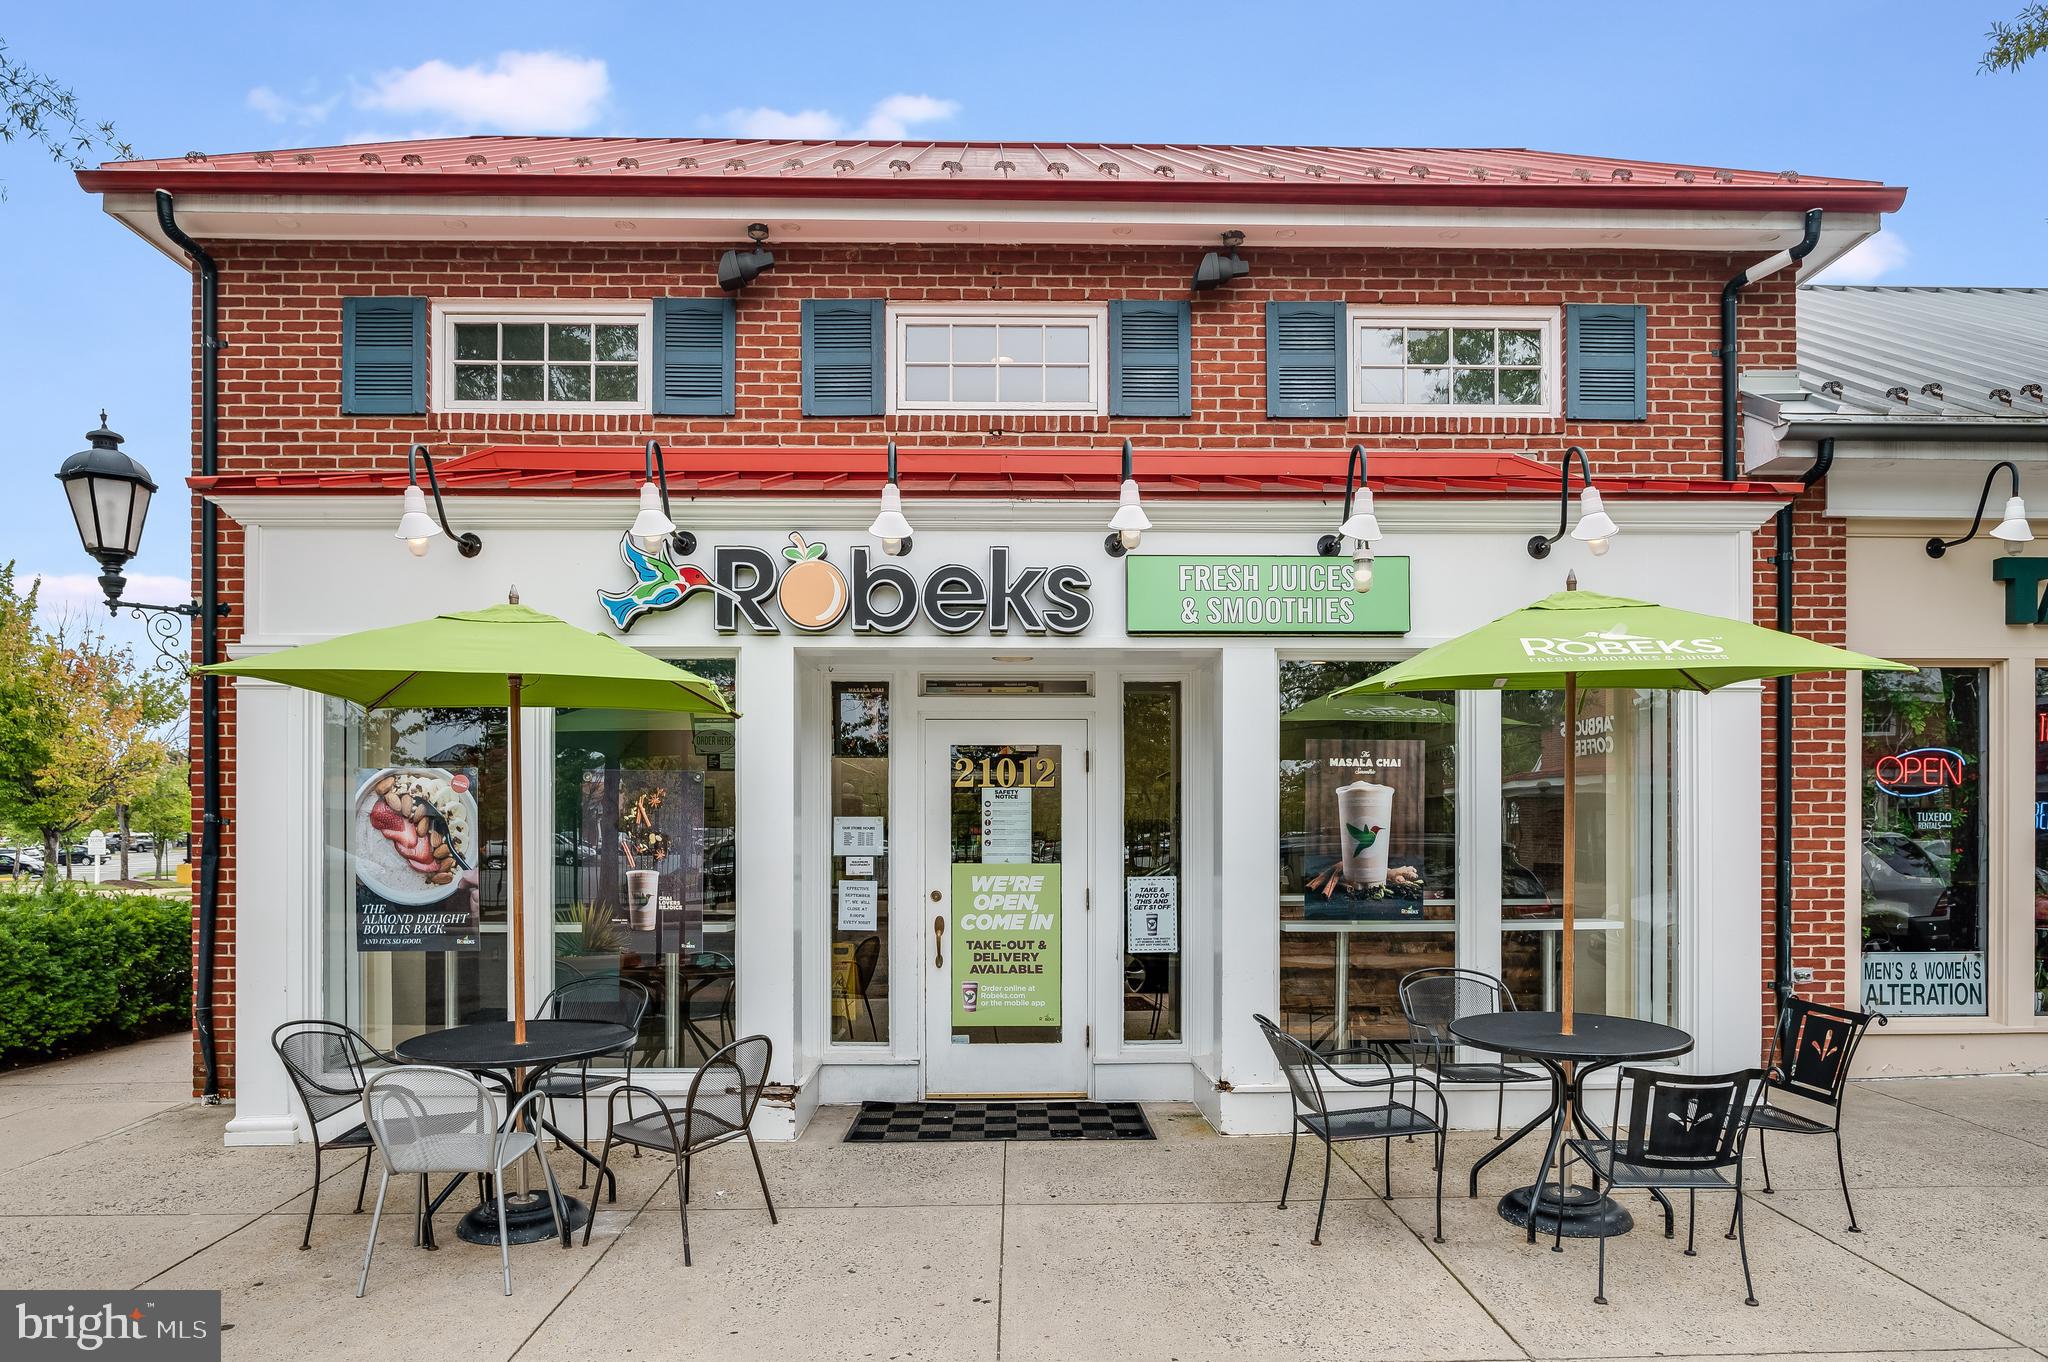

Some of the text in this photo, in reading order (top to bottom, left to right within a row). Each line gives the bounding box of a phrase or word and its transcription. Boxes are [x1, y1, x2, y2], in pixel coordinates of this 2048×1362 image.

[1179, 565, 1355, 591] FRESH JUICES
[713, 545, 1094, 635] Robeks
[1181, 597, 1354, 624] & SMOOTHIES
[1579, 655, 1660, 663] SMOOTHIES
[697, 736, 732, 746] ORDER HERE
[1329, 758, 1402, 767] MASALA CHAI
[954, 758, 1056, 788] 21012
[1876, 755, 1962, 785] OPEN
[1917, 812, 1952, 821] TUXEDO
[971, 875, 1045, 892] WE'RE
[362, 904, 386, 914] THE
[973, 894, 1039, 913] OPEN,
[362, 913, 470, 925] ALMOND DELIGHT
[961, 913, 1054, 931] COME IN
[363, 924, 447, 935] BOWL IS BACK.
[966, 940, 1047, 950] TAKE-OUT &
[973, 953, 1040, 962] DELIVERY
[969, 965, 1044, 974] AVAILABLE
[1864, 961, 1981, 980] MEN'S & WOMEN'S
[1865, 982, 1983, 1006] ALTERATION
